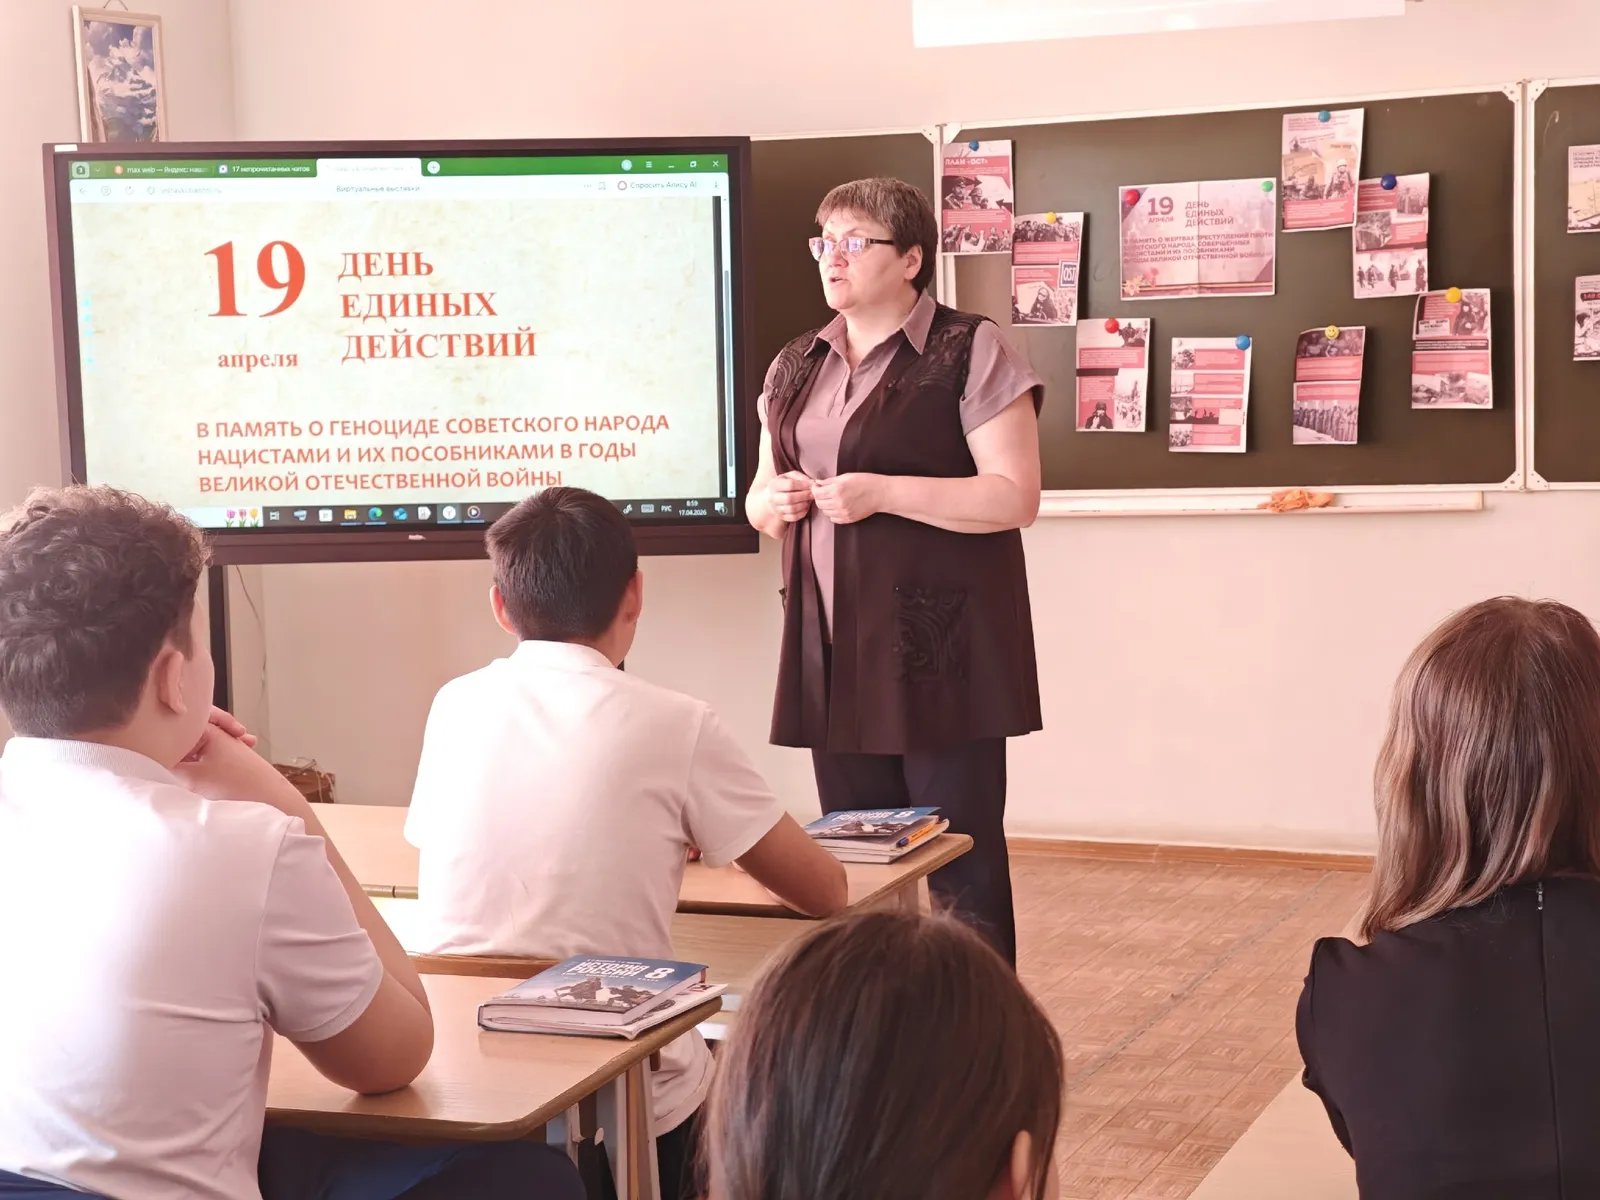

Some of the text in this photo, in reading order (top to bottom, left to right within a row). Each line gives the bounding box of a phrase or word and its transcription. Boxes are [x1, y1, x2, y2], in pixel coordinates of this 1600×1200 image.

[240, 166, 290, 174] непрочитанных
[1148, 196, 1174, 216] 19
[1185, 201, 1210, 210] ДЕНЬ
[1185, 209, 1224, 218] ЕДИНЫХ
[1148, 215, 1174, 224] АПРЕЛЯ
[1185, 217, 1234, 227] ДЕЙСТВИЙ
[337, 251, 434, 283] ДЕНЬ
[203, 240, 306, 318] 19
[340, 291, 498, 324] ЕДИНЫХ
[341, 326, 538, 366] ДЕЙСТВИЙ
[217, 353, 299, 373] апреля
[196, 414, 670, 440] В ПАМЯТЬ О ГЕНОЦИДЕ СОВЕТСКОГО НАРОДА
[198, 442, 637, 469] НАЦИСТАМИ И ИХ ПОСОБНИКАМИ В ГОДЫ
[199, 468, 563, 492] ВЕЛИКОЙ ОТЕЧЕСТВЕННОЙ ВОЙНЫ
[661, 505, 672, 513] РУС
[679, 508, 707, 517] 17.04.2026
[644, 967, 675, 979] 8
